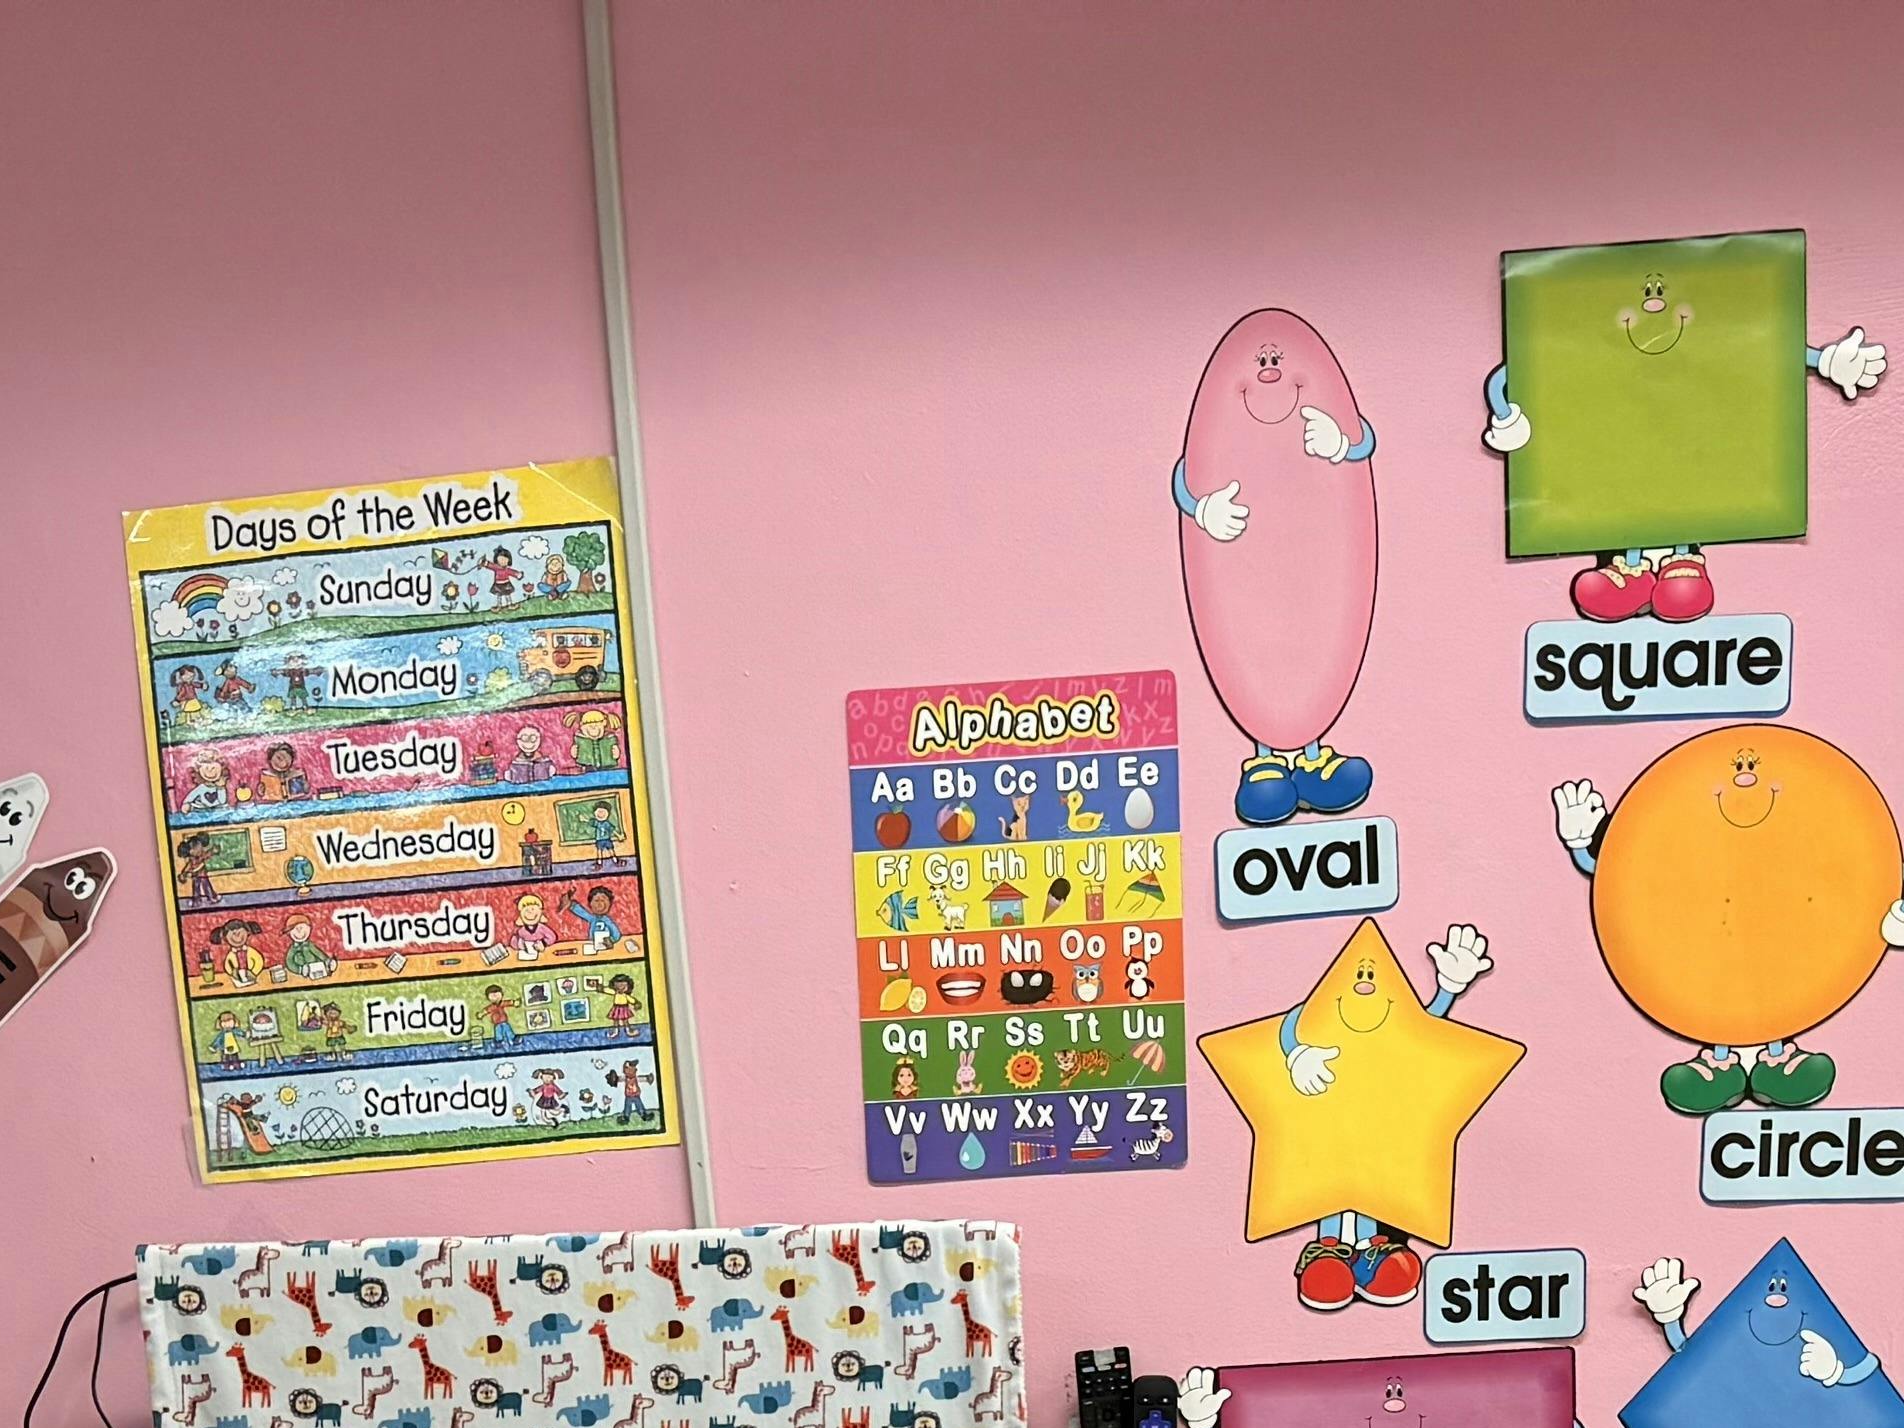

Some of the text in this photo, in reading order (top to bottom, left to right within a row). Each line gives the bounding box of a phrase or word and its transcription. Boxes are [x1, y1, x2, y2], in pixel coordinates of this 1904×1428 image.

[212, 483, 512, 553] Days of the Week
[320, 571, 432, 609] Sunday
[329, 663, 457, 698] Monday
[1533, 634, 1783, 711] square
[914, 695, 1115, 749] Alphabet
[327, 739, 458, 776] Tuesday
[871, 756, 1160, 804] Aa Bb Cc Dd Ee
[316, 825, 496, 864] Wednesday
[875, 840, 1165, 889] Ff Gg Hh Ii Jj Kk
[1232, 826, 1379, 896] oval
[337, 907, 491, 947] Thursday
[879, 926, 1163, 971] Ll Mm Nn Oo Pp
[367, 1001, 466, 1036] Friday
[882, 1010, 1165, 1057] Qq Rr Ss Tt Uu
[363, 1082, 508, 1118] Saturday
[884, 1093, 1168, 1136] Vv Ww Xx Yy Zz
[1440, 1266, 1568, 1324] star
